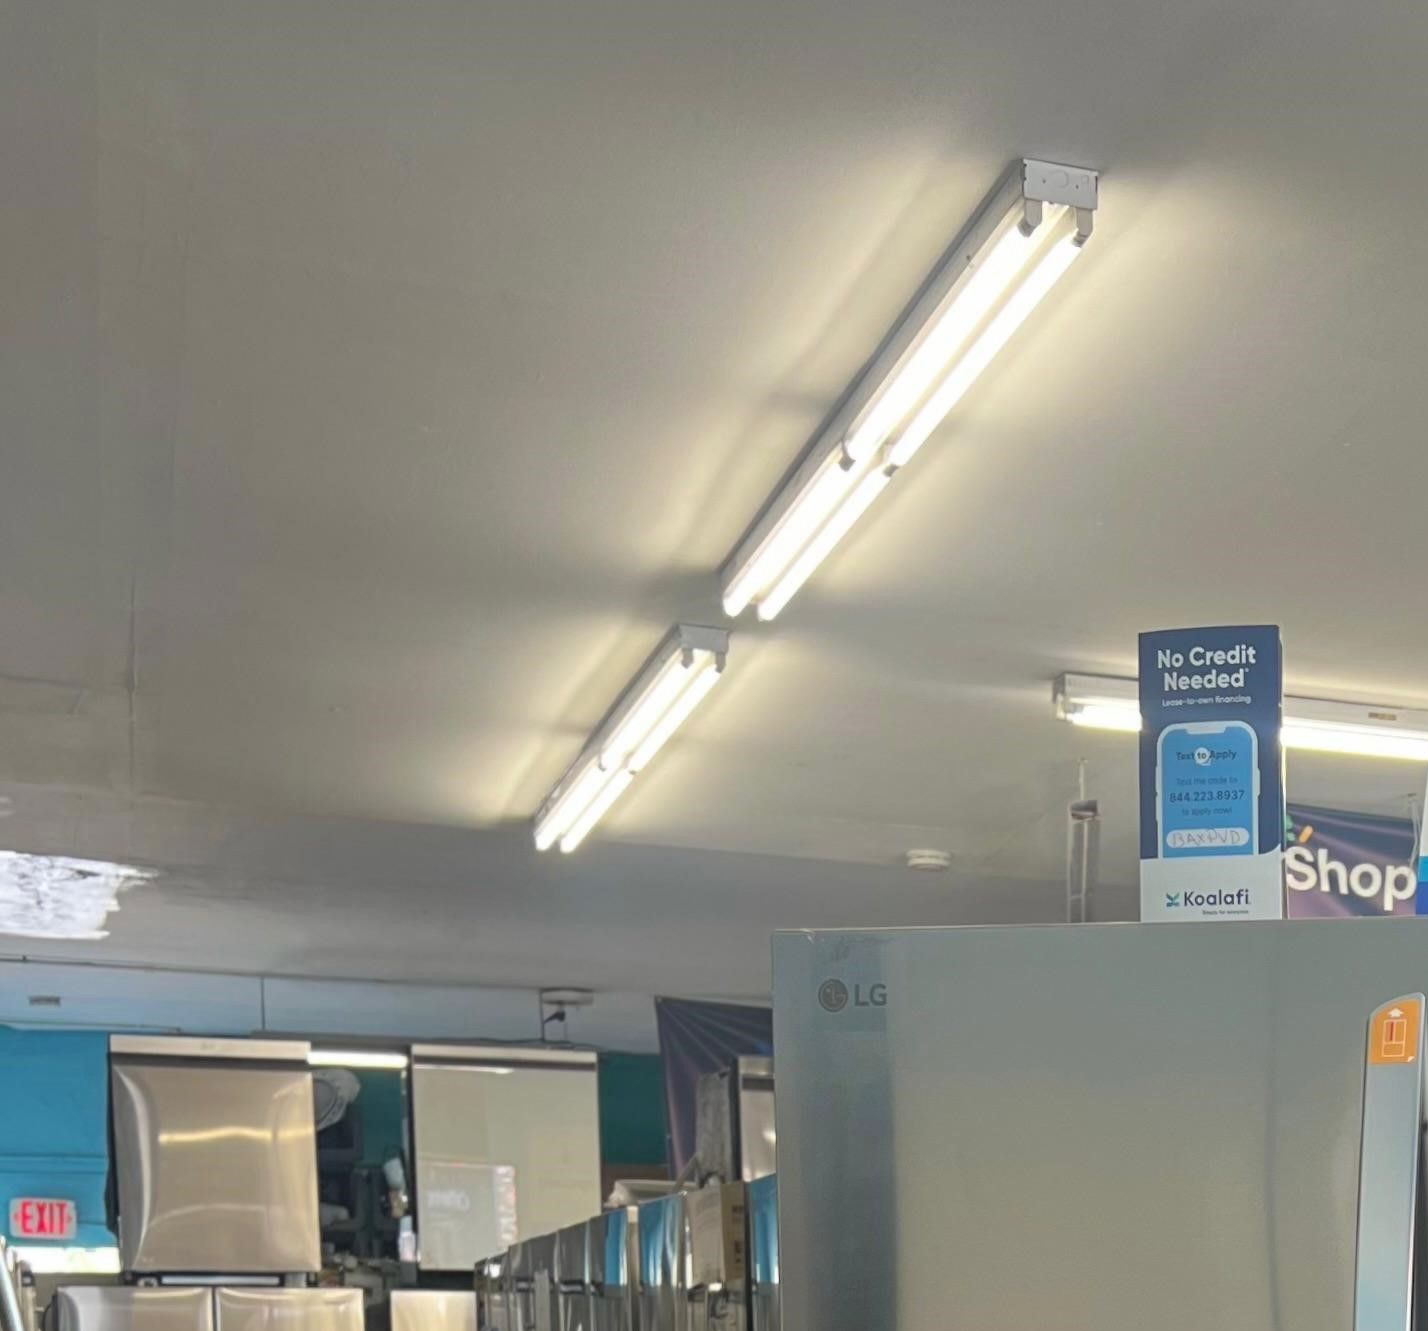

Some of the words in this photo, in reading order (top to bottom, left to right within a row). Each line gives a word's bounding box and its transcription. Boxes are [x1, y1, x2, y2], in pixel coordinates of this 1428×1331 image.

[1157, 649, 1184, 669] No
[1189, 644, 1256, 666] Credit
[1176, 751, 1195, 760] Text
[1197, 752, 1207, 760] to
[1209, 750, 1237, 762] Apply
[1286, 846, 1417, 911] Shop
[1184, 889, 1250, 907] Koalafi
[854, 983, 888, 1007] LG
[22, 1202, 67, 1233] EXIT
